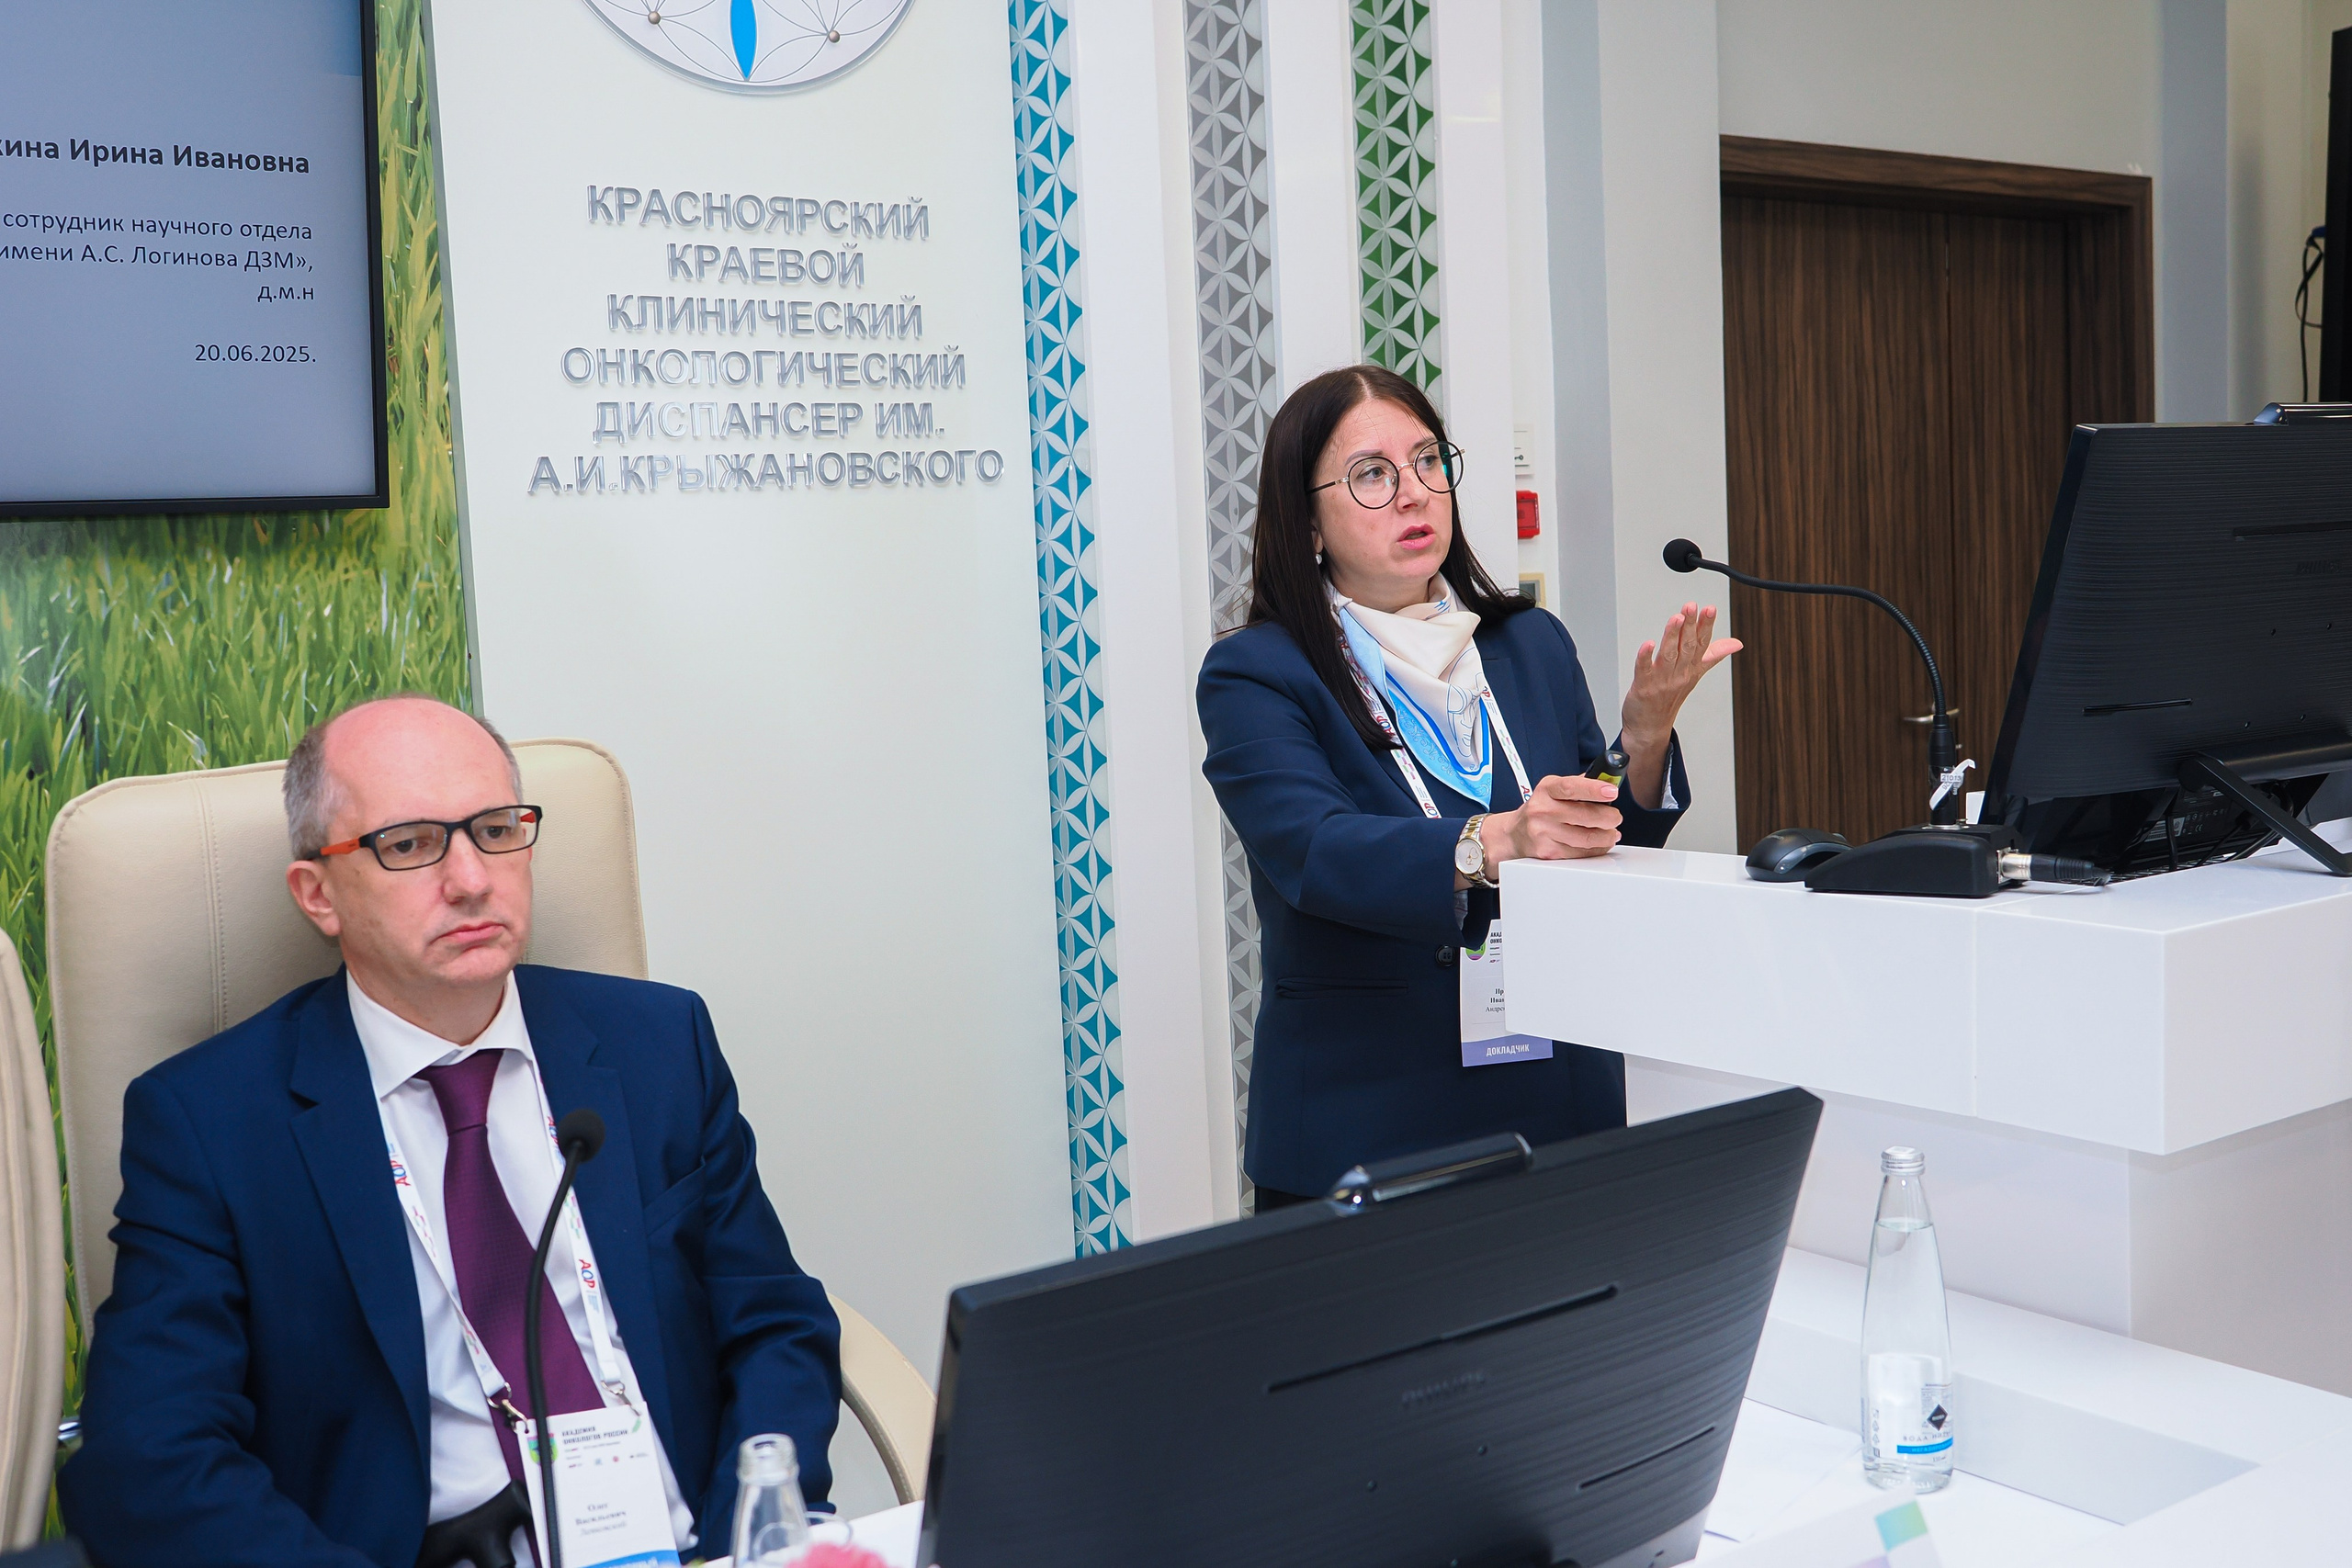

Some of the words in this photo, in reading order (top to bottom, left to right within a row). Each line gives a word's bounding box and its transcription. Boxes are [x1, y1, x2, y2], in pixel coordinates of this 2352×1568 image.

[70, 139, 164, 167] Ирина
[174, 145, 310, 174] Ивановна
[3, 212, 125, 233] сотрудник
[131, 219, 232, 238] научного
[240, 224, 312, 241] отдела
[586, 185, 930, 240] КРАСНОЯРСКИЙ
[0, 245, 74, 262] имени
[81, 244, 124, 264] А.С.
[131, 246, 237, 267] Логинова
[243, 251, 313, 273] ДЗМ»,
[667, 243, 865, 287] КРАЕВОЙ
[258, 286, 314, 302] д.м.н
[606, 293, 922, 338] КЛИНИЧЕСКИЙ
[195, 344, 316, 363] 20.06.2025.
[560, 344, 966, 389] ОНКОЛОГИЧЕСКИЙ
[593, 401, 864, 445] ДИСПАНСЕР
[876, 402, 945, 438] ИМ.
[1486, 1043, 1530, 1057] ДОКЛАДЧИК
